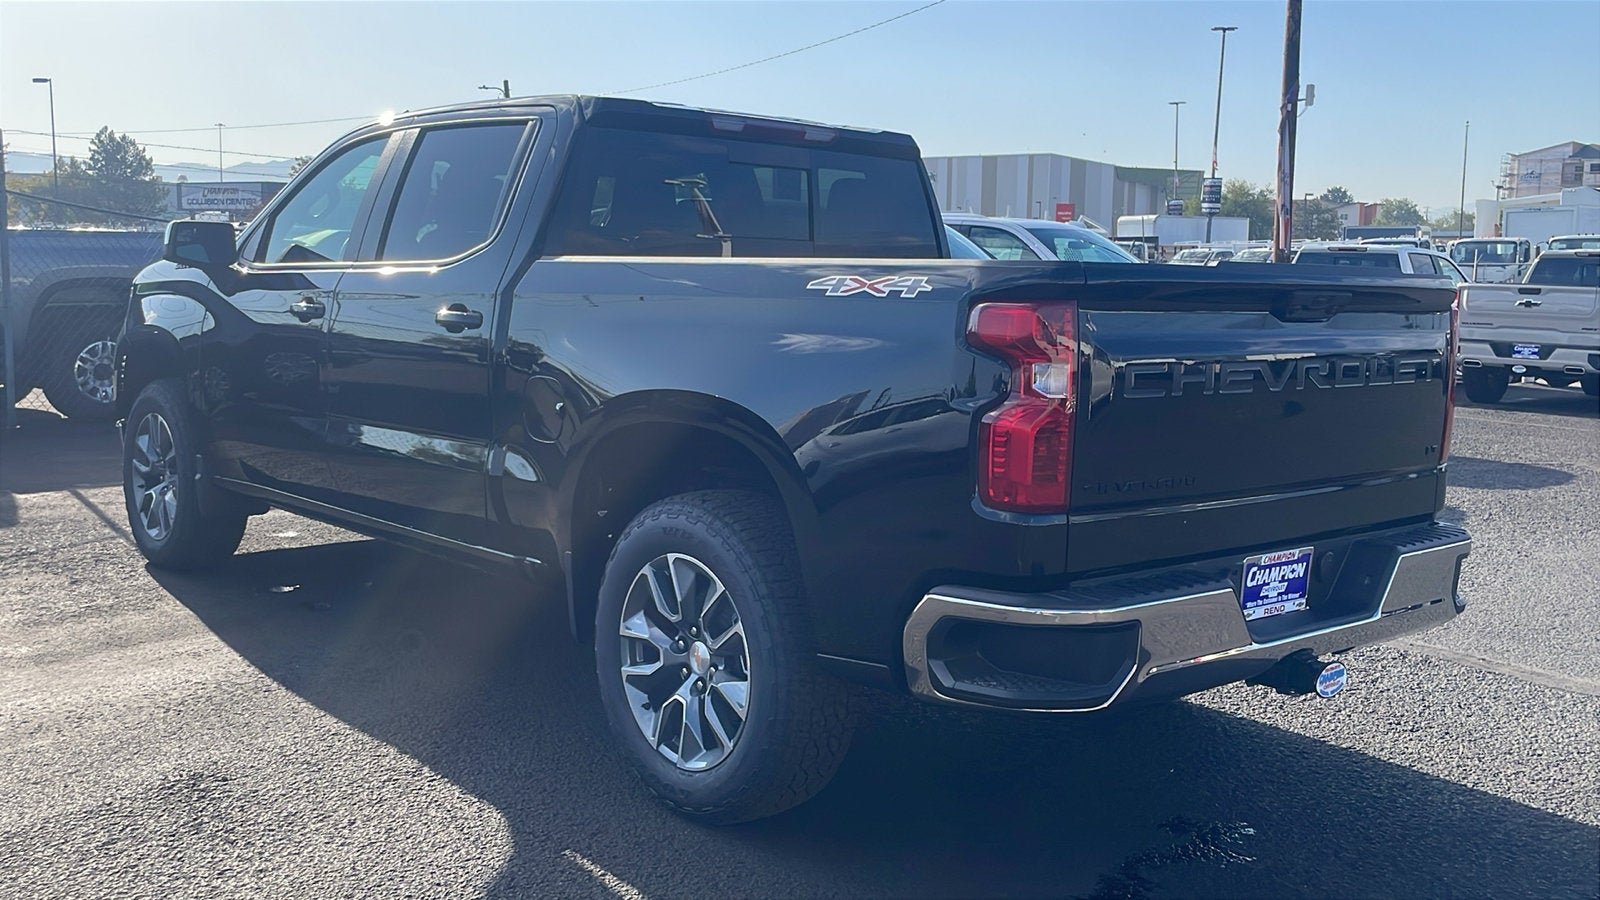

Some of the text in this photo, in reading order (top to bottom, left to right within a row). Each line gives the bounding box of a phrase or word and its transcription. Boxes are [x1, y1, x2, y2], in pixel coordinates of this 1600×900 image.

[187, 198, 257, 207] COLLISION CENTER
[1123, 357, 1442, 399] CHEVROLET
[1264, 551, 1296, 564] CHAMPION
[1246, 562, 1307, 588] CHAMPION
[1263, 604, 1286, 616] RENO
